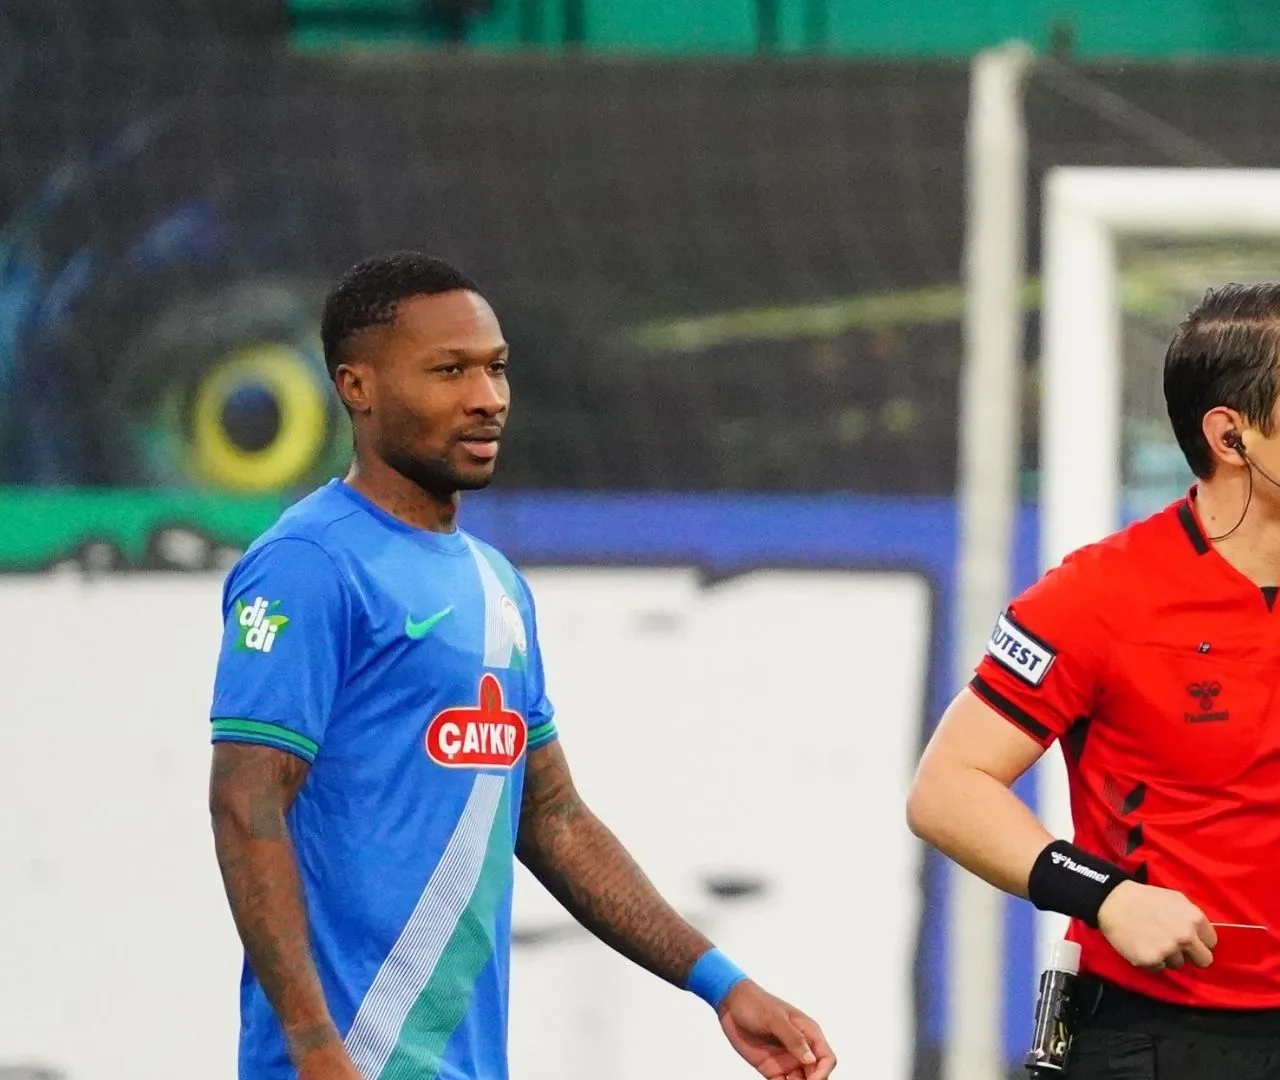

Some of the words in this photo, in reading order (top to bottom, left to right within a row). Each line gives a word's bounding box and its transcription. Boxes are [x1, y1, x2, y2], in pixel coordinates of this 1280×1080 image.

[239, 596, 269, 628] di
[245, 619, 278, 653] di
[1062, 857, 1110, 884] hummel
